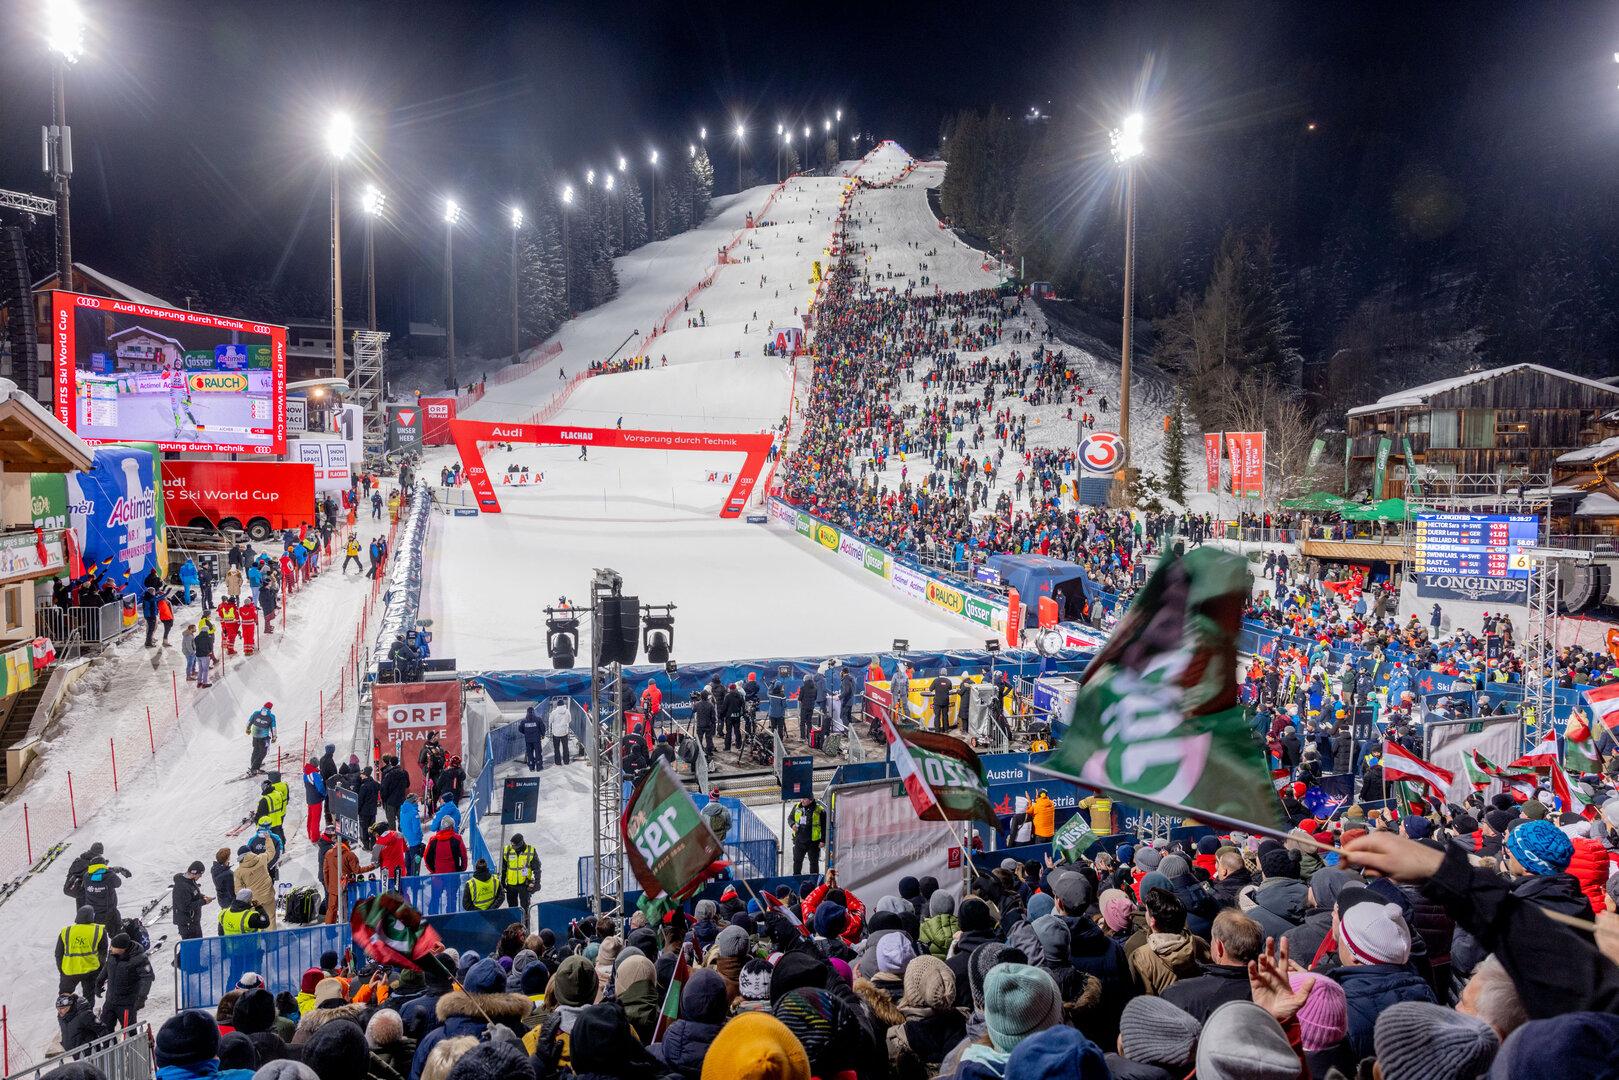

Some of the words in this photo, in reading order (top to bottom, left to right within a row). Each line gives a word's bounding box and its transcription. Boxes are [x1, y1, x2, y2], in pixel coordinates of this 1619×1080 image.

[59, 310, 68, 331] Cup
[113, 302, 136, 312] Audi
[138, 306, 185, 321] Vorsprung
[187, 314, 211, 324] durch
[213, 319, 244, 329] Technik
[59, 333, 68, 366] World
[59, 369, 68, 384] Ski
[204, 378, 240, 388] RAUCH
[60, 386, 68, 404] FIS
[397, 427, 416, 435] UNSER
[400, 434, 415, 442] HEER
[492, 427, 523, 437] Audi
[560, 431, 593, 440] FLACHAU
[623, 434, 672, 444] Vorsprung
[674, 435, 701, 444] durch
[703, 437, 737, 446] Technik
[189, 443, 213, 451] durch
[214, 444, 244, 452] Technik
[180, 490, 200, 500] Ski
[204, 490, 248, 500] World
[252, 491, 279, 501] Cup
[108, 491, 155, 526] Actimel
[840, 538, 864, 561] Actimel
[1517, 556, 1526, 568] 6
[1425, 575, 1527, 592] LONGINES
[935, 587, 959, 608] RAUCH
[964, 594, 990, 622] Gösser
[1437, 683, 1450, 692] Ski
[392, 707, 443, 724] ORF
[388, 728, 414, 742] FÜR
[986, 769, 1024, 780] Austria
[1052, 795, 1075, 808] stria
[1125, 816, 1143, 830] Ski
[635, 806, 680, 869] ser
